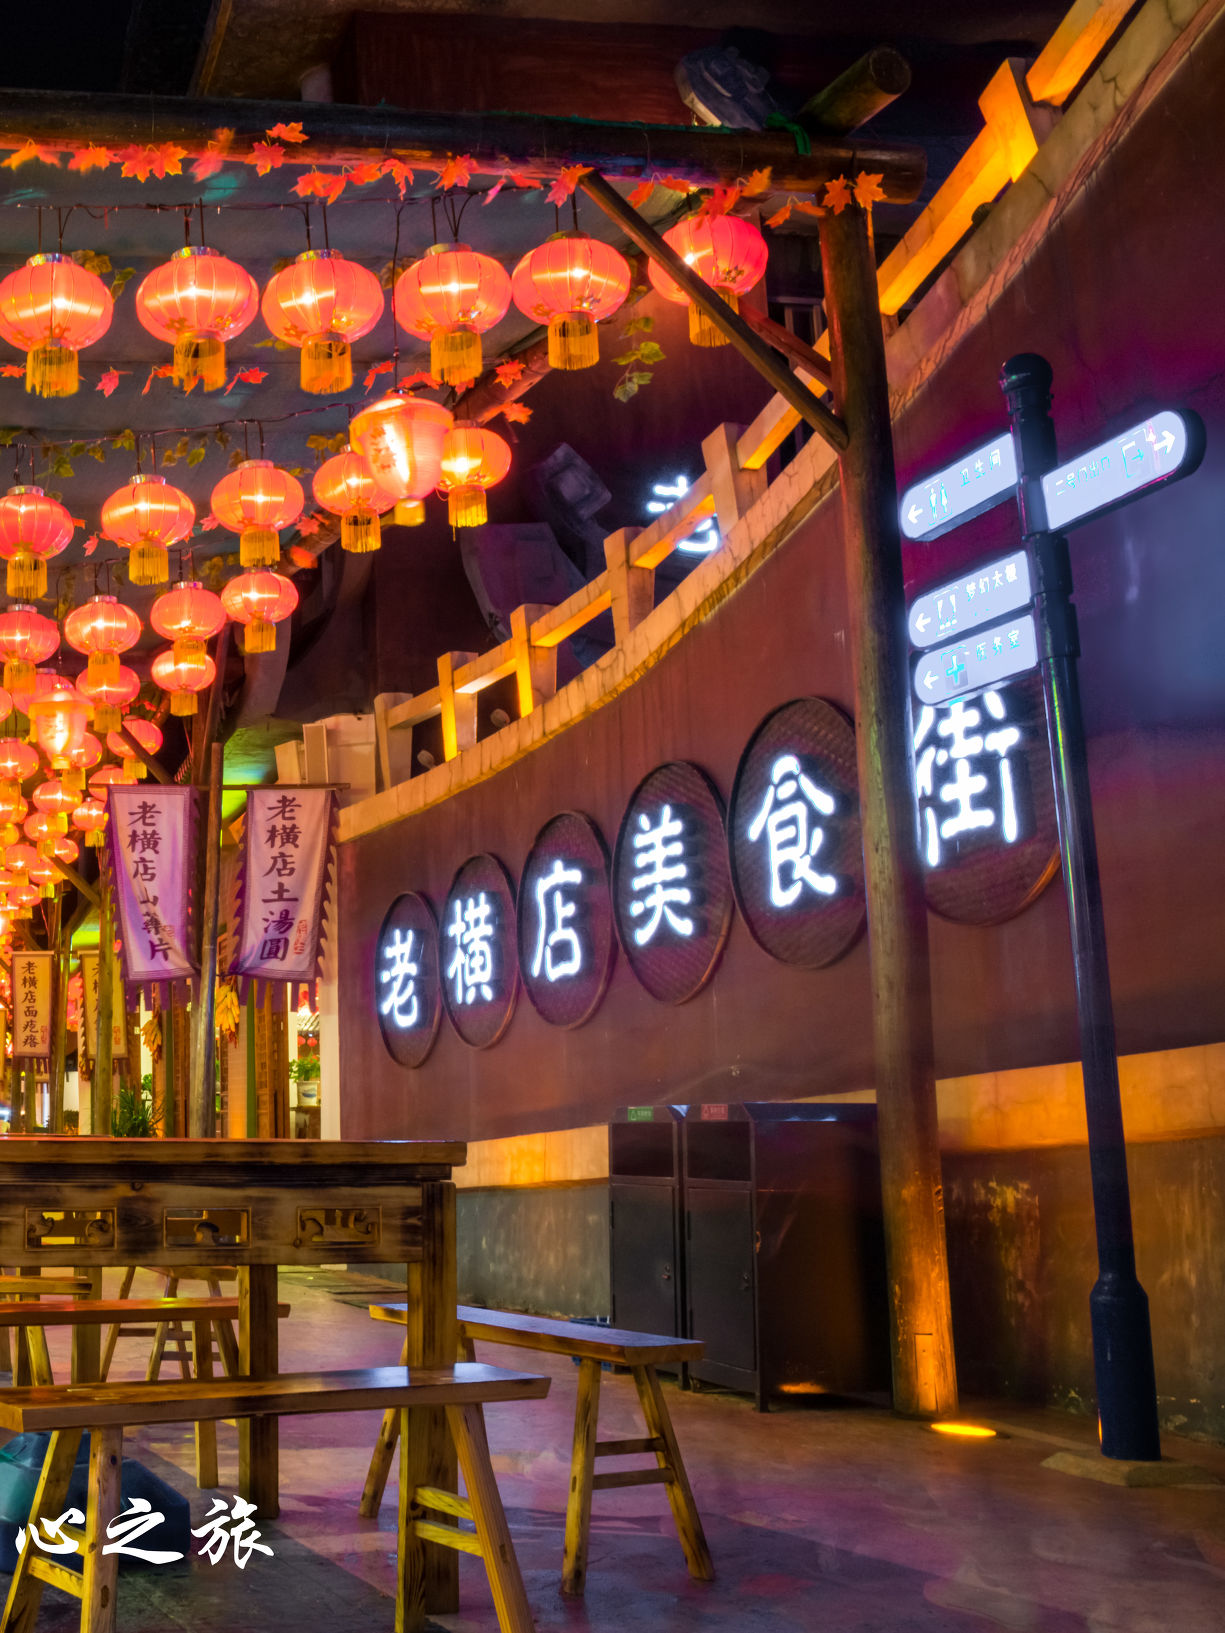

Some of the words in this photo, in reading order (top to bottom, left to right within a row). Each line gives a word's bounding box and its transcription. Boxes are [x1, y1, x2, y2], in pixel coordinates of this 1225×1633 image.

[379, 689, 1020, 1028] 老横店美食街
